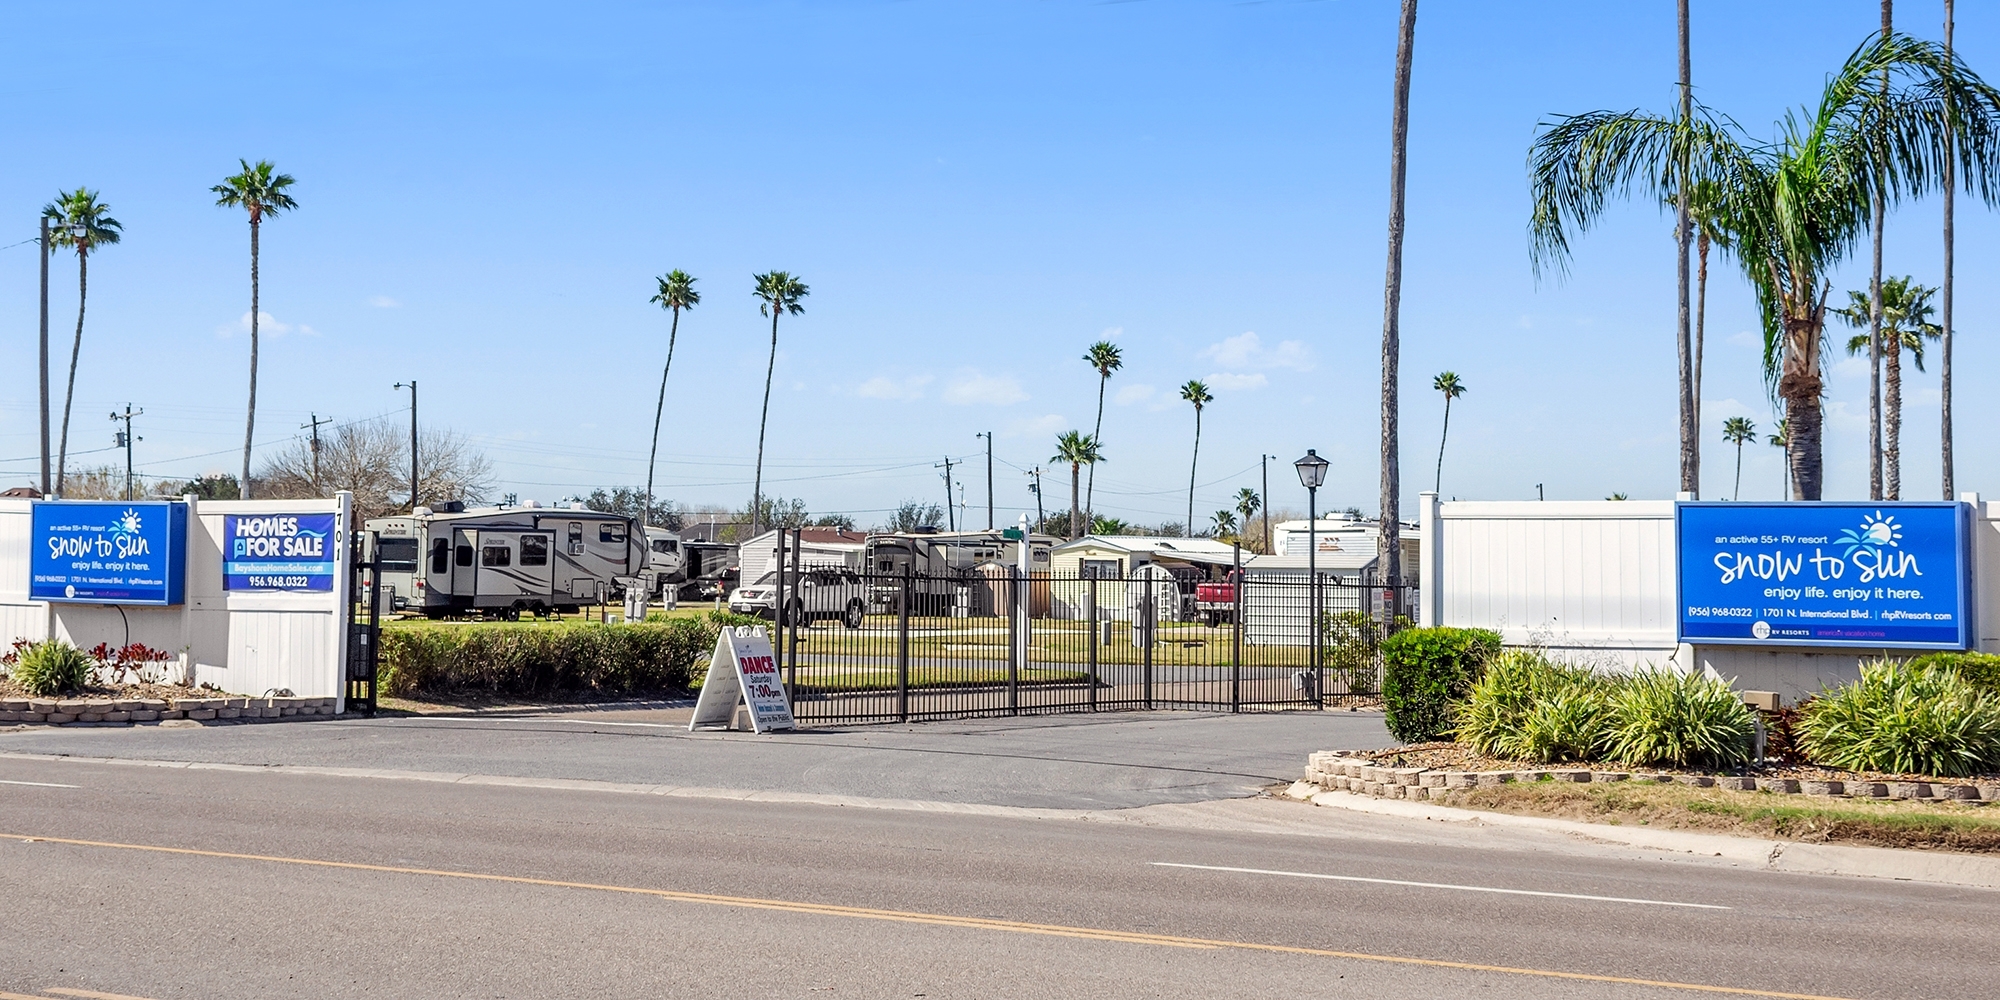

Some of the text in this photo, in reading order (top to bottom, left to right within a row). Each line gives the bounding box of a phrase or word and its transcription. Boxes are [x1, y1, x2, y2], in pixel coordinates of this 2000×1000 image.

[236, 517, 298, 537] HOMES
[1715, 535, 1828, 544] an active 55+ RV resort
[48, 533, 151, 560] snow to sun
[246, 537, 323, 556] FOR SALE
[71, 561, 150, 572] enjoy life. enjoy it here.
[234, 563, 324, 574] BayshoreHomeSales.com
[1713, 548, 1923, 585] snow to sun
[249, 576, 307, 587] 956.968.0322
[1763, 586, 1924, 601] enjoy life. enjoy it here.
[1688, 606, 1710, 617] (956)
[1712, 608, 1752, 617] 968-0322
[1763, 608, 1783, 617] 1701
[1787, 609, 1797, 617] N.
[1800, 609, 1849, 618] International
[740, 656, 775, 674] DANCE
[750, 675, 772, 684] Saturday
[749, 685, 770, 698] 7:00
